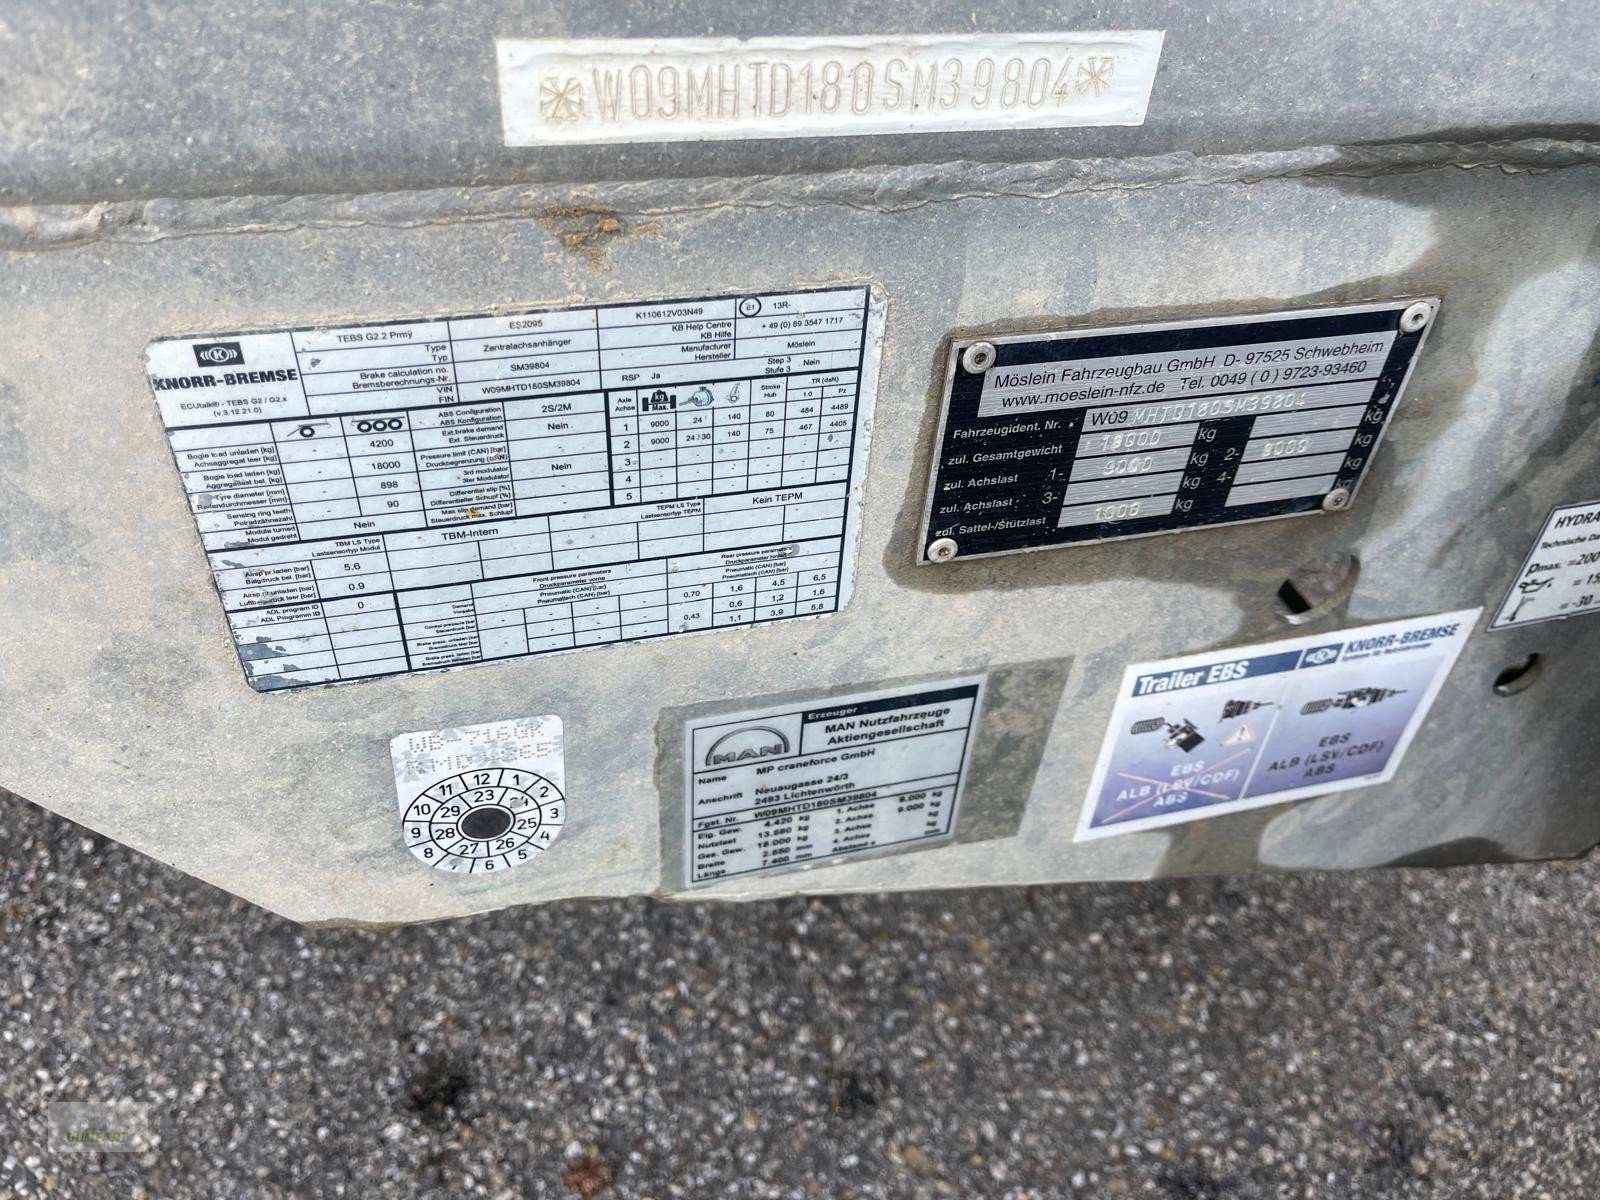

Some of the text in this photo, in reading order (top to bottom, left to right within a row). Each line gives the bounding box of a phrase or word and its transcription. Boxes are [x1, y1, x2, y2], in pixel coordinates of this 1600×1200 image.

[509, 319, 542, 329] ES2095
[672, 320, 731, 332] KB Help Centre
[768, 316, 843, 330] 49 (0) 89 3547 1717
[336, 332, 387, 343] TEBS G2.2
[701, 330, 731, 339] KB Hilfe
[425, 343, 446, 353] Type
[483, 337, 571, 352] Zentralachsanhänger
[681, 342, 730, 353] Manufacturer
[787, 339, 815, 348] Möslein
[432, 354, 448, 362] Typ
[694, 351, 730, 360] Hersteller
[767, 357, 784, 365] Step
[510, 361, 549, 371] SM39804
[803, 358, 820, 366] Nein
[993, 339, 1385, 389] Möslein Fahrzeugbau GmbH D- 97525 Schwebheim
[360, 371, 385, 380] Brake
[390, 367, 433, 377] calculation
[765, 366, 783, 374] Stufe
[154, 367, 298, 392] KNORR-BREMSE
[352, 374, 450, 391] Bremsberechnungs-Nr.
[621, 374, 639, 382] RSP
[436, 386, 453, 394] VIN
[1001, 360, 1368, 409] www.moeslein-nfz.de Tel. 0049 9723-93460
[438, 395, 454, 403] FIN
[541, 403, 571, 413] 2S/2M
[650, 419, 668, 428] 9000
[765, 409, 774, 417] 80
[830, 402, 848, 411] 4489
[547, 421, 568, 430] Nein
[952, 420, 1041, 441] Fahrzeugident.
[1046, 418, 1062, 429] Nr.
[651, 437, 669, 445] 9000
[765, 426, 773, 434] 75
[829, 419, 847, 427] 4405
[948, 454, 970, 465] zul.
[971, 444, 1062, 466] Gesamtgewicht
[1195, 425, 1218, 443] kg
[1362, 407, 1385, 424] kg
[369, 439, 394, 448] 4200
[371, 460, 400, 471] 18000
[551, 462, 571, 470] Nein
[624, 458, 630, 466] 3
[943, 431, 1375, 491] zul. Achslast kg 2- kg
[380, 480, 398, 489] 898
[625, 475, 631, 483] 4
[939, 454, 1364, 515] zul. Achslast 3- kg 4- kg
[626, 492, 632, 500] 5
[752, 492, 802, 504] Kein TEPM
[387, 500, 399, 508] 90
[958, 496, 1194, 535] Sattel-/Stützlast kg
[353, 520, 375, 529] Nein
[441, 527, 498, 541] TBM-Intern
[343, 562, 360, 571] 5.6
[347, 582, 365, 591] 0.9
[357, 601, 364, 609] 0
[1344, 623, 1461, 653] KNORR-BREMSE
[1135, 660, 1250, 695] Trailer EBS
[808, 706, 857, 720] Erzeuger
[824, 707, 950, 734] MAN Nutzfahrzeuge
[827, 718, 945, 746] Aktiengesellschaft
[1316, 732, 1352, 747] EBS
[713, 743, 783, 764] MAN
[698, 748, 875, 785] Name MP craneforce GmbH
[1169, 760, 1206, 777] EBS
[1268, 756, 1301, 771] ALB
[1302, 763, 1336, 778] ABS
[473, 773, 490, 786] 12
[513, 775, 520, 785] 1
[439, 784, 453, 796] 11
[540, 786, 549, 797] 2
[698, 791, 743, 805] Anschrift
[826, 773, 848, 783] 24/3
[783, 781, 855, 800] Lichtenwörth
[1115, 783, 1152, 801] ALB
[474, 790, 494, 803] 23
[414, 804, 431, 816] 10
[441, 806, 460, 818] 29
[550, 808, 559, 818] 3
[517, 817, 537, 830] 25
[411, 828, 421, 838] 9
[436, 828, 455, 840] 28
[541, 831, 549, 840] 4
[460, 842, 479, 855] 27
[496, 838, 514, 850] 26
[424, 848, 433, 858] 8
[518, 850, 527, 859] 5
[485, 859, 494, 870] 6
